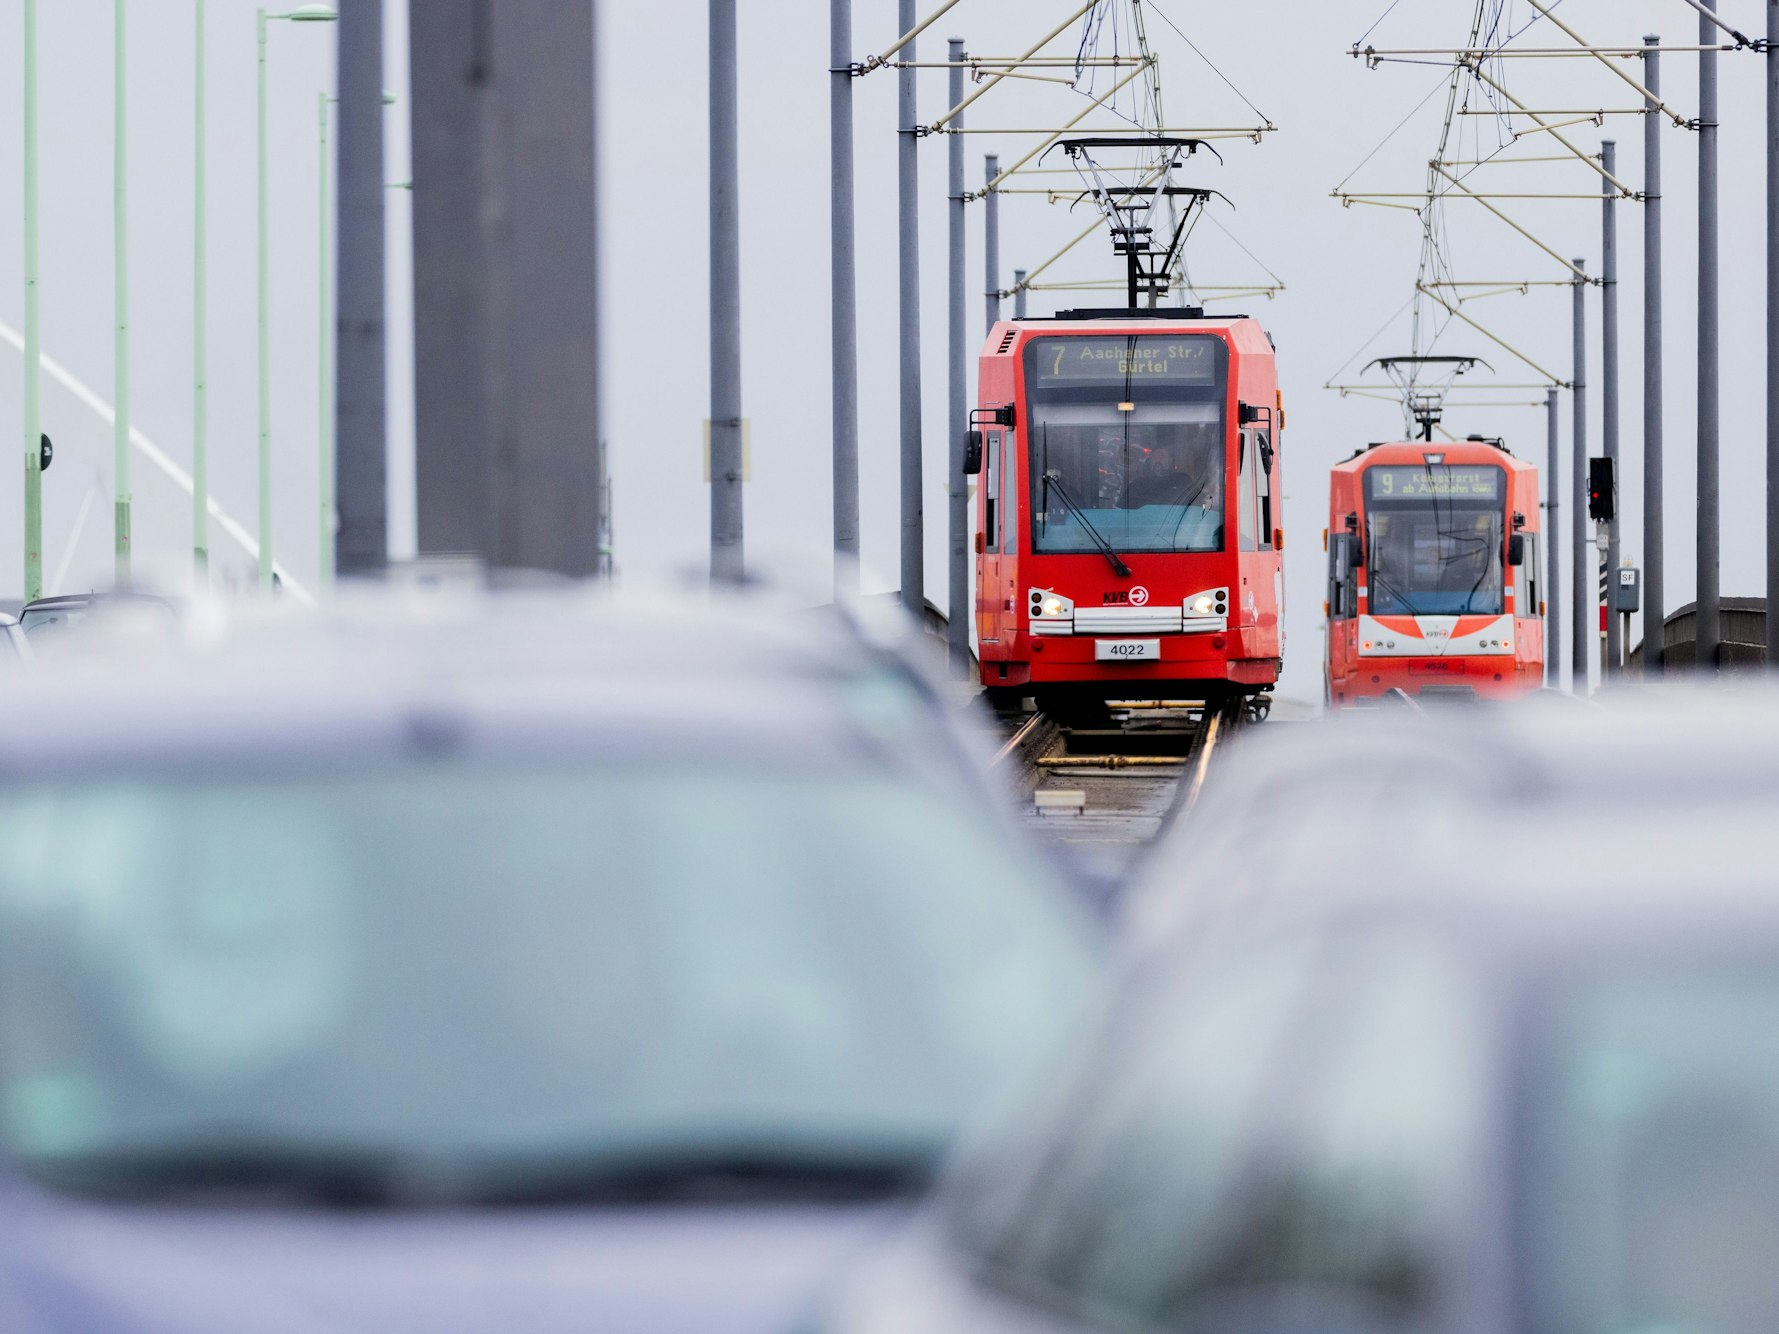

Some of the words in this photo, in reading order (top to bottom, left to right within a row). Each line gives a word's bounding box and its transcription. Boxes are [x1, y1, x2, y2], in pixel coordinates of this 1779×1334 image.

[1080, 347, 1157, 360] Aachener
[1168, 345, 1204, 358] Str./
[1052, 346, 1065, 375] 7
[1118, 360, 1168, 373] Gürtel
[1382, 473, 1392, 494] 9
[1622, 574, 1633, 582] SF
[1103, 592, 1128, 603] KVB
[1110, 645, 1144, 655] 4022
